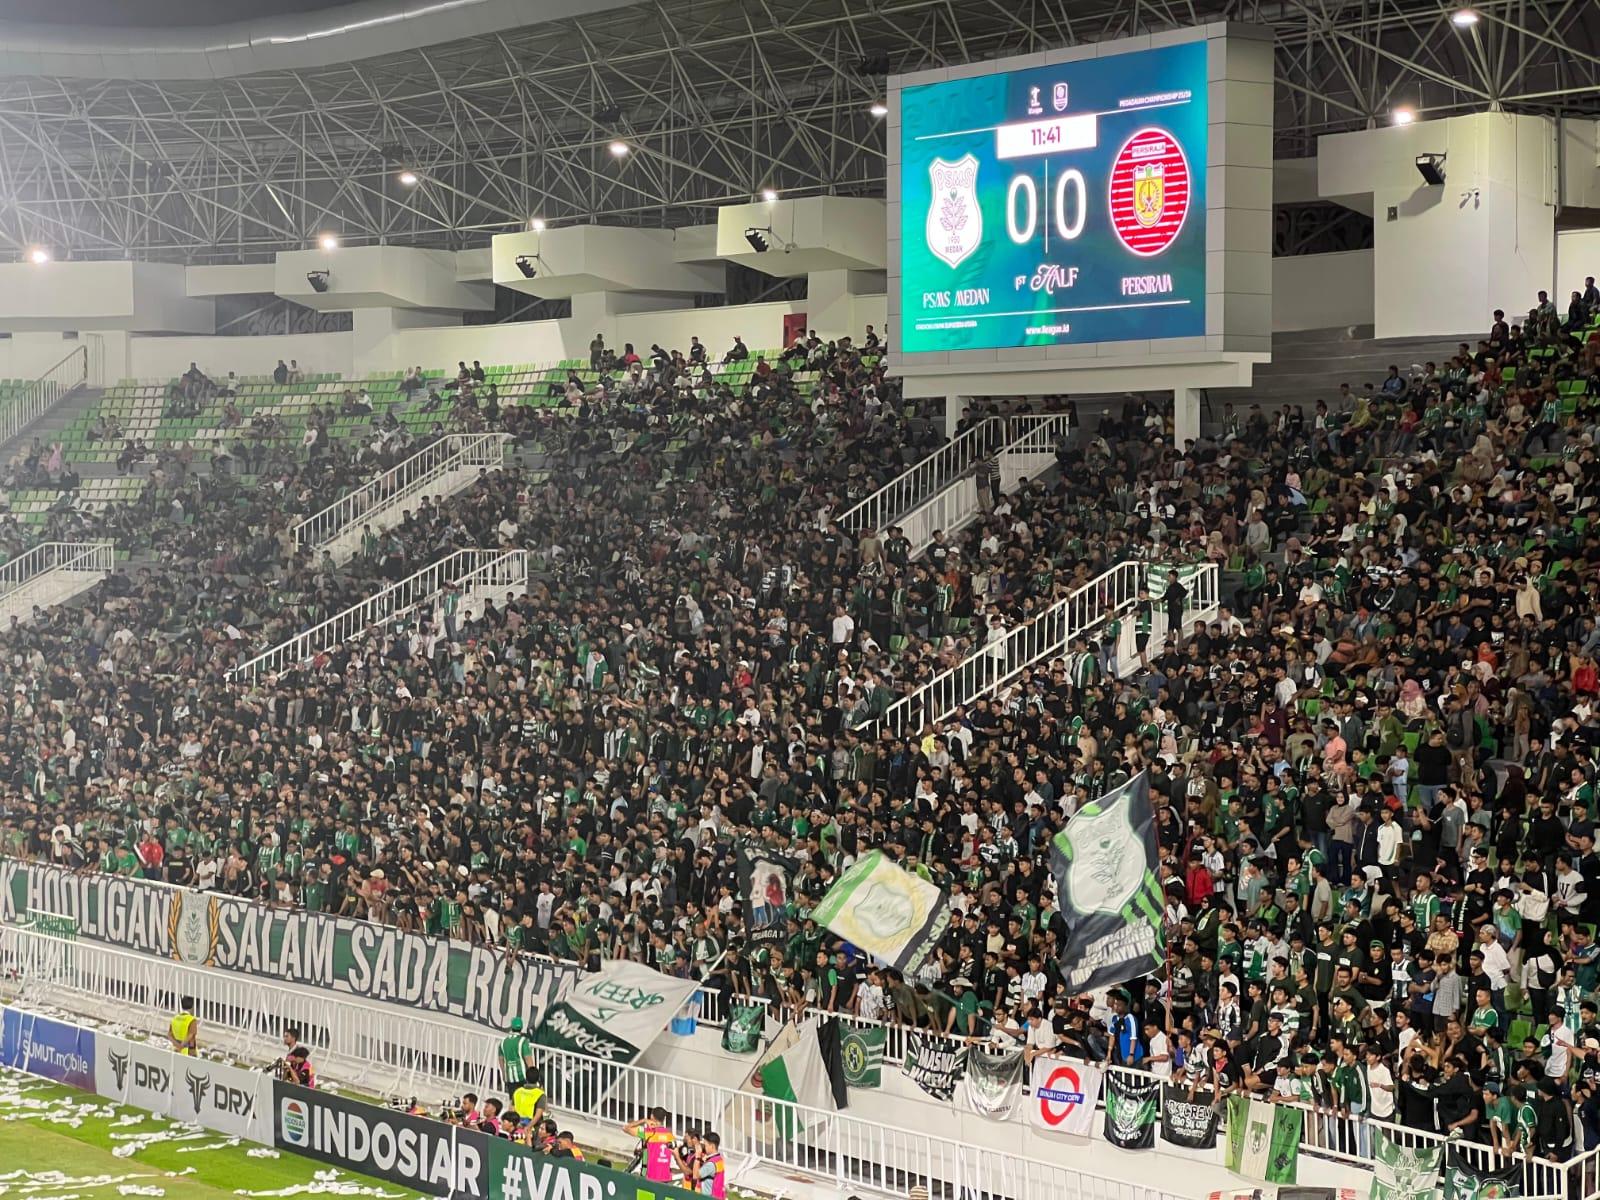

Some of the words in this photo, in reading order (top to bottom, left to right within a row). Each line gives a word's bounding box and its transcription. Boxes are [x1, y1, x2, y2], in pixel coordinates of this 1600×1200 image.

[1031, 126, 1061, 146] 11:41
[1006, 174, 1037, 244] 0
[1056, 168, 1086, 240] 0
[922, 290, 951, 309] PSMS
[954, 287, 990, 307] MEDAN
[1122, 274, 1173, 295] PERSIRAJA
[27, 865, 170, 955] HOOLIGAN
[217, 902, 336, 985] SALAM
[348, 924, 449, 1007] SADA
[583, 979, 665, 1010] GREEN
[134, 1061, 174, 1097] DRX
[213, 1082, 257, 1120] DRX
[313, 1104, 481, 1197] INDOSIAR
